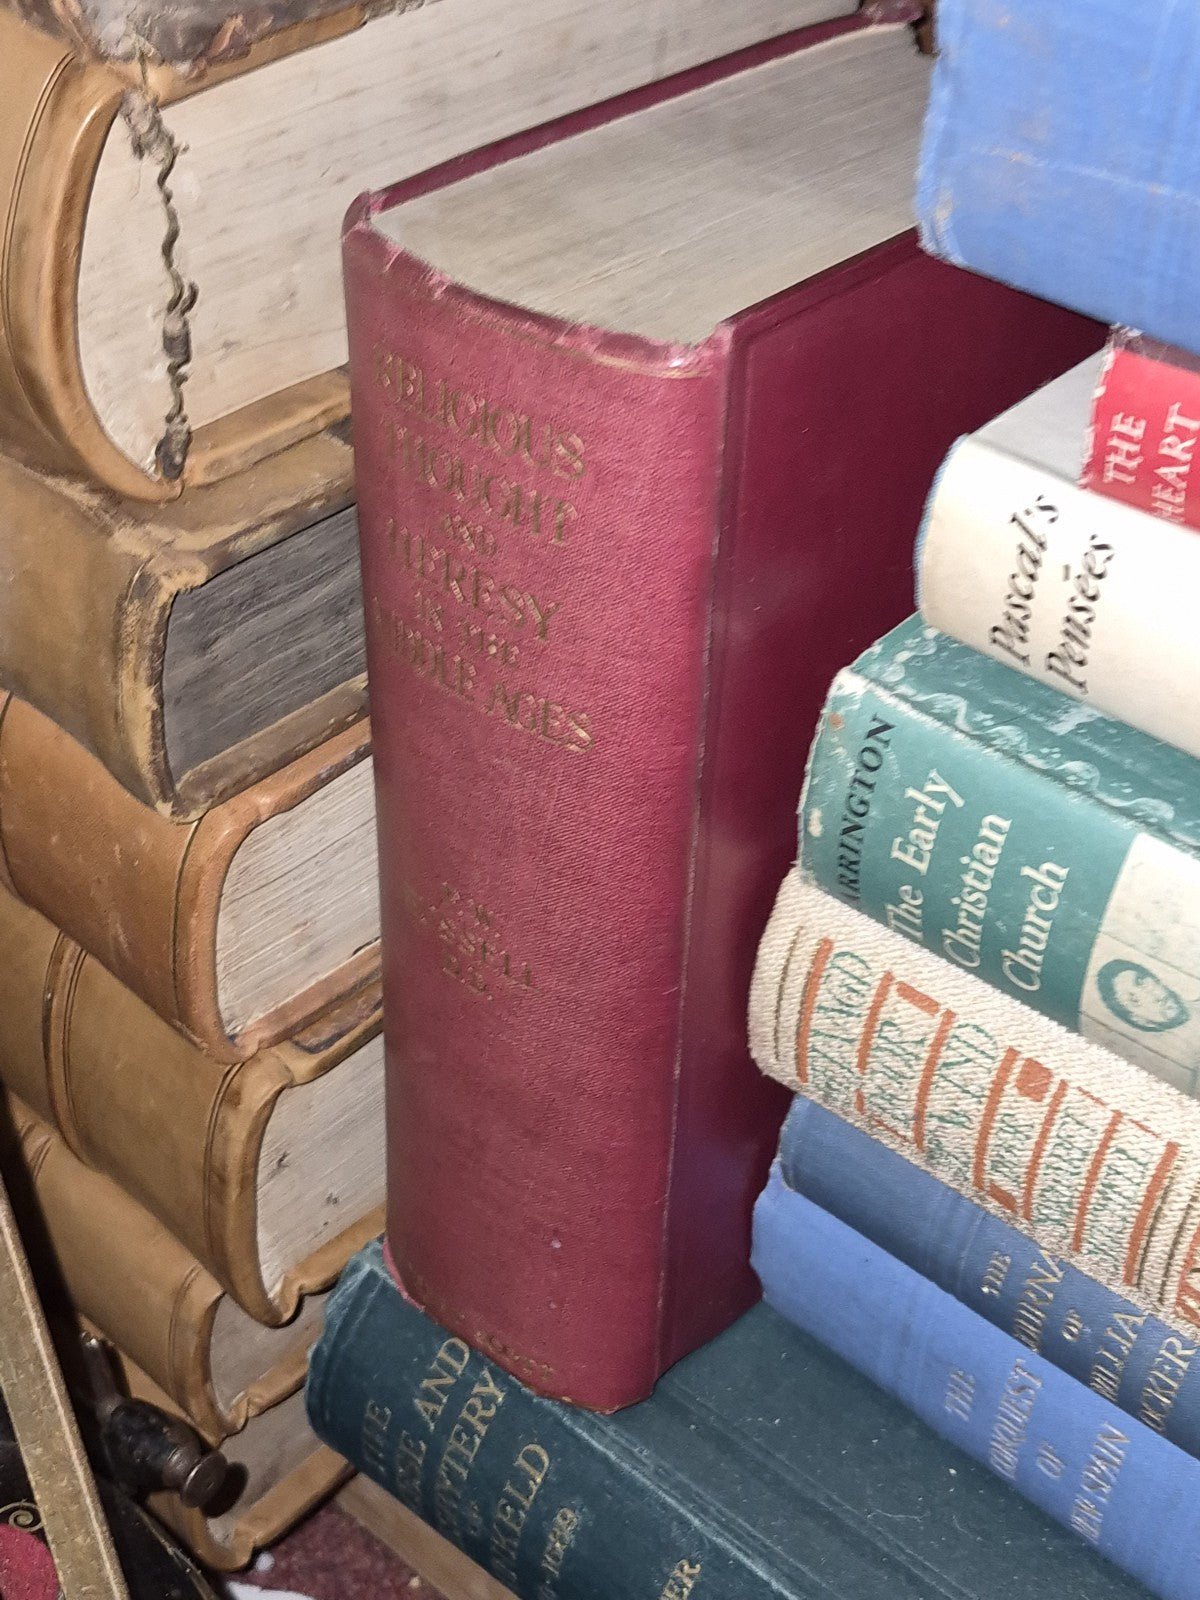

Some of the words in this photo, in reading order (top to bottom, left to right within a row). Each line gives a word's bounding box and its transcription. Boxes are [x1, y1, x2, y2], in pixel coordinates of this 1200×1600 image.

[1103, 411, 1147, 485] THE
[1150, 401, 1200, 523] HEART
[988, 494, 1060, 667] Pascal's
[486, 682, 596, 755] AGES
[889, 768, 966, 876] Early
[885, 873, 925, 942] The
[941, 813, 1014, 968] Christian
[1001, 860, 1071, 992] Church
[412, 1336, 470, 1433] AND
[944, 1369, 977, 1422] THE
[988, 1358, 1044, 1481] CONQUEST
[1035, 1440, 1067, 1479] OF
[1080, 1421, 1131, 1504] SPAIN
